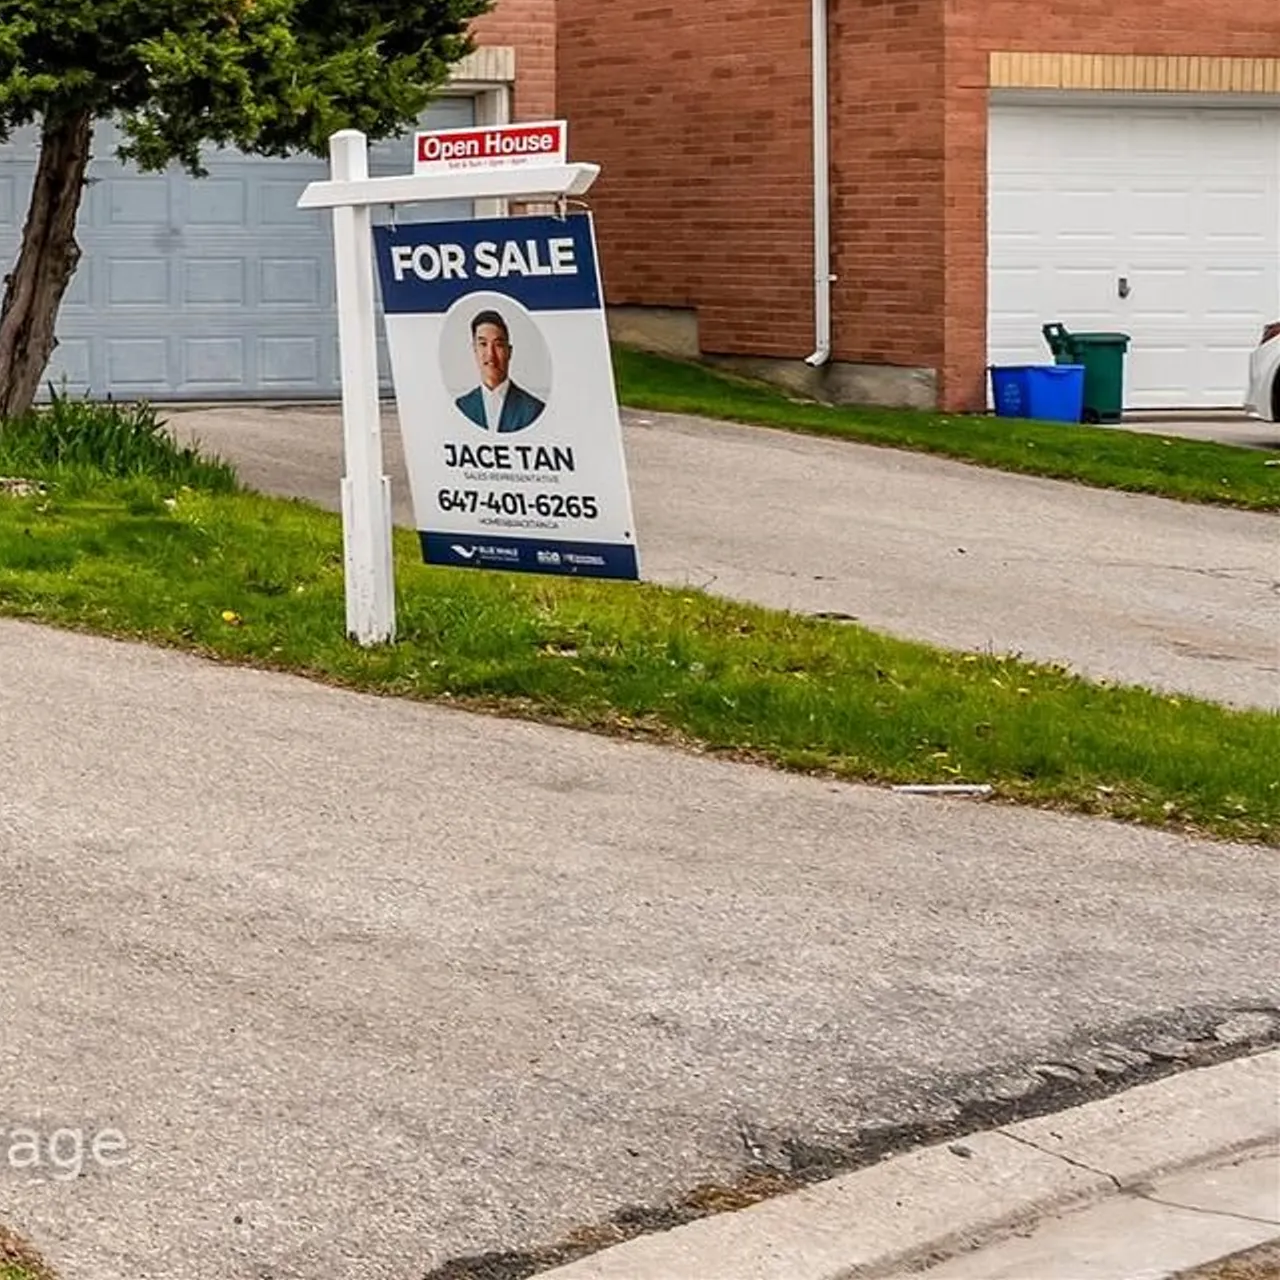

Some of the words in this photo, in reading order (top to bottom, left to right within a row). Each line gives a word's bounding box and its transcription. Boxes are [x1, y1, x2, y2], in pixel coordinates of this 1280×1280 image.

[423, 137, 479, 161] Open
[485, 132, 553, 154] House
[391, 244, 468, 281] FOR
[474, 238, 578, 278] SALE
[444, 444, 512, 469] JACE
[515, 446, 575, 471] TAN
[438, 489, 598, 518] 647-401-6265
